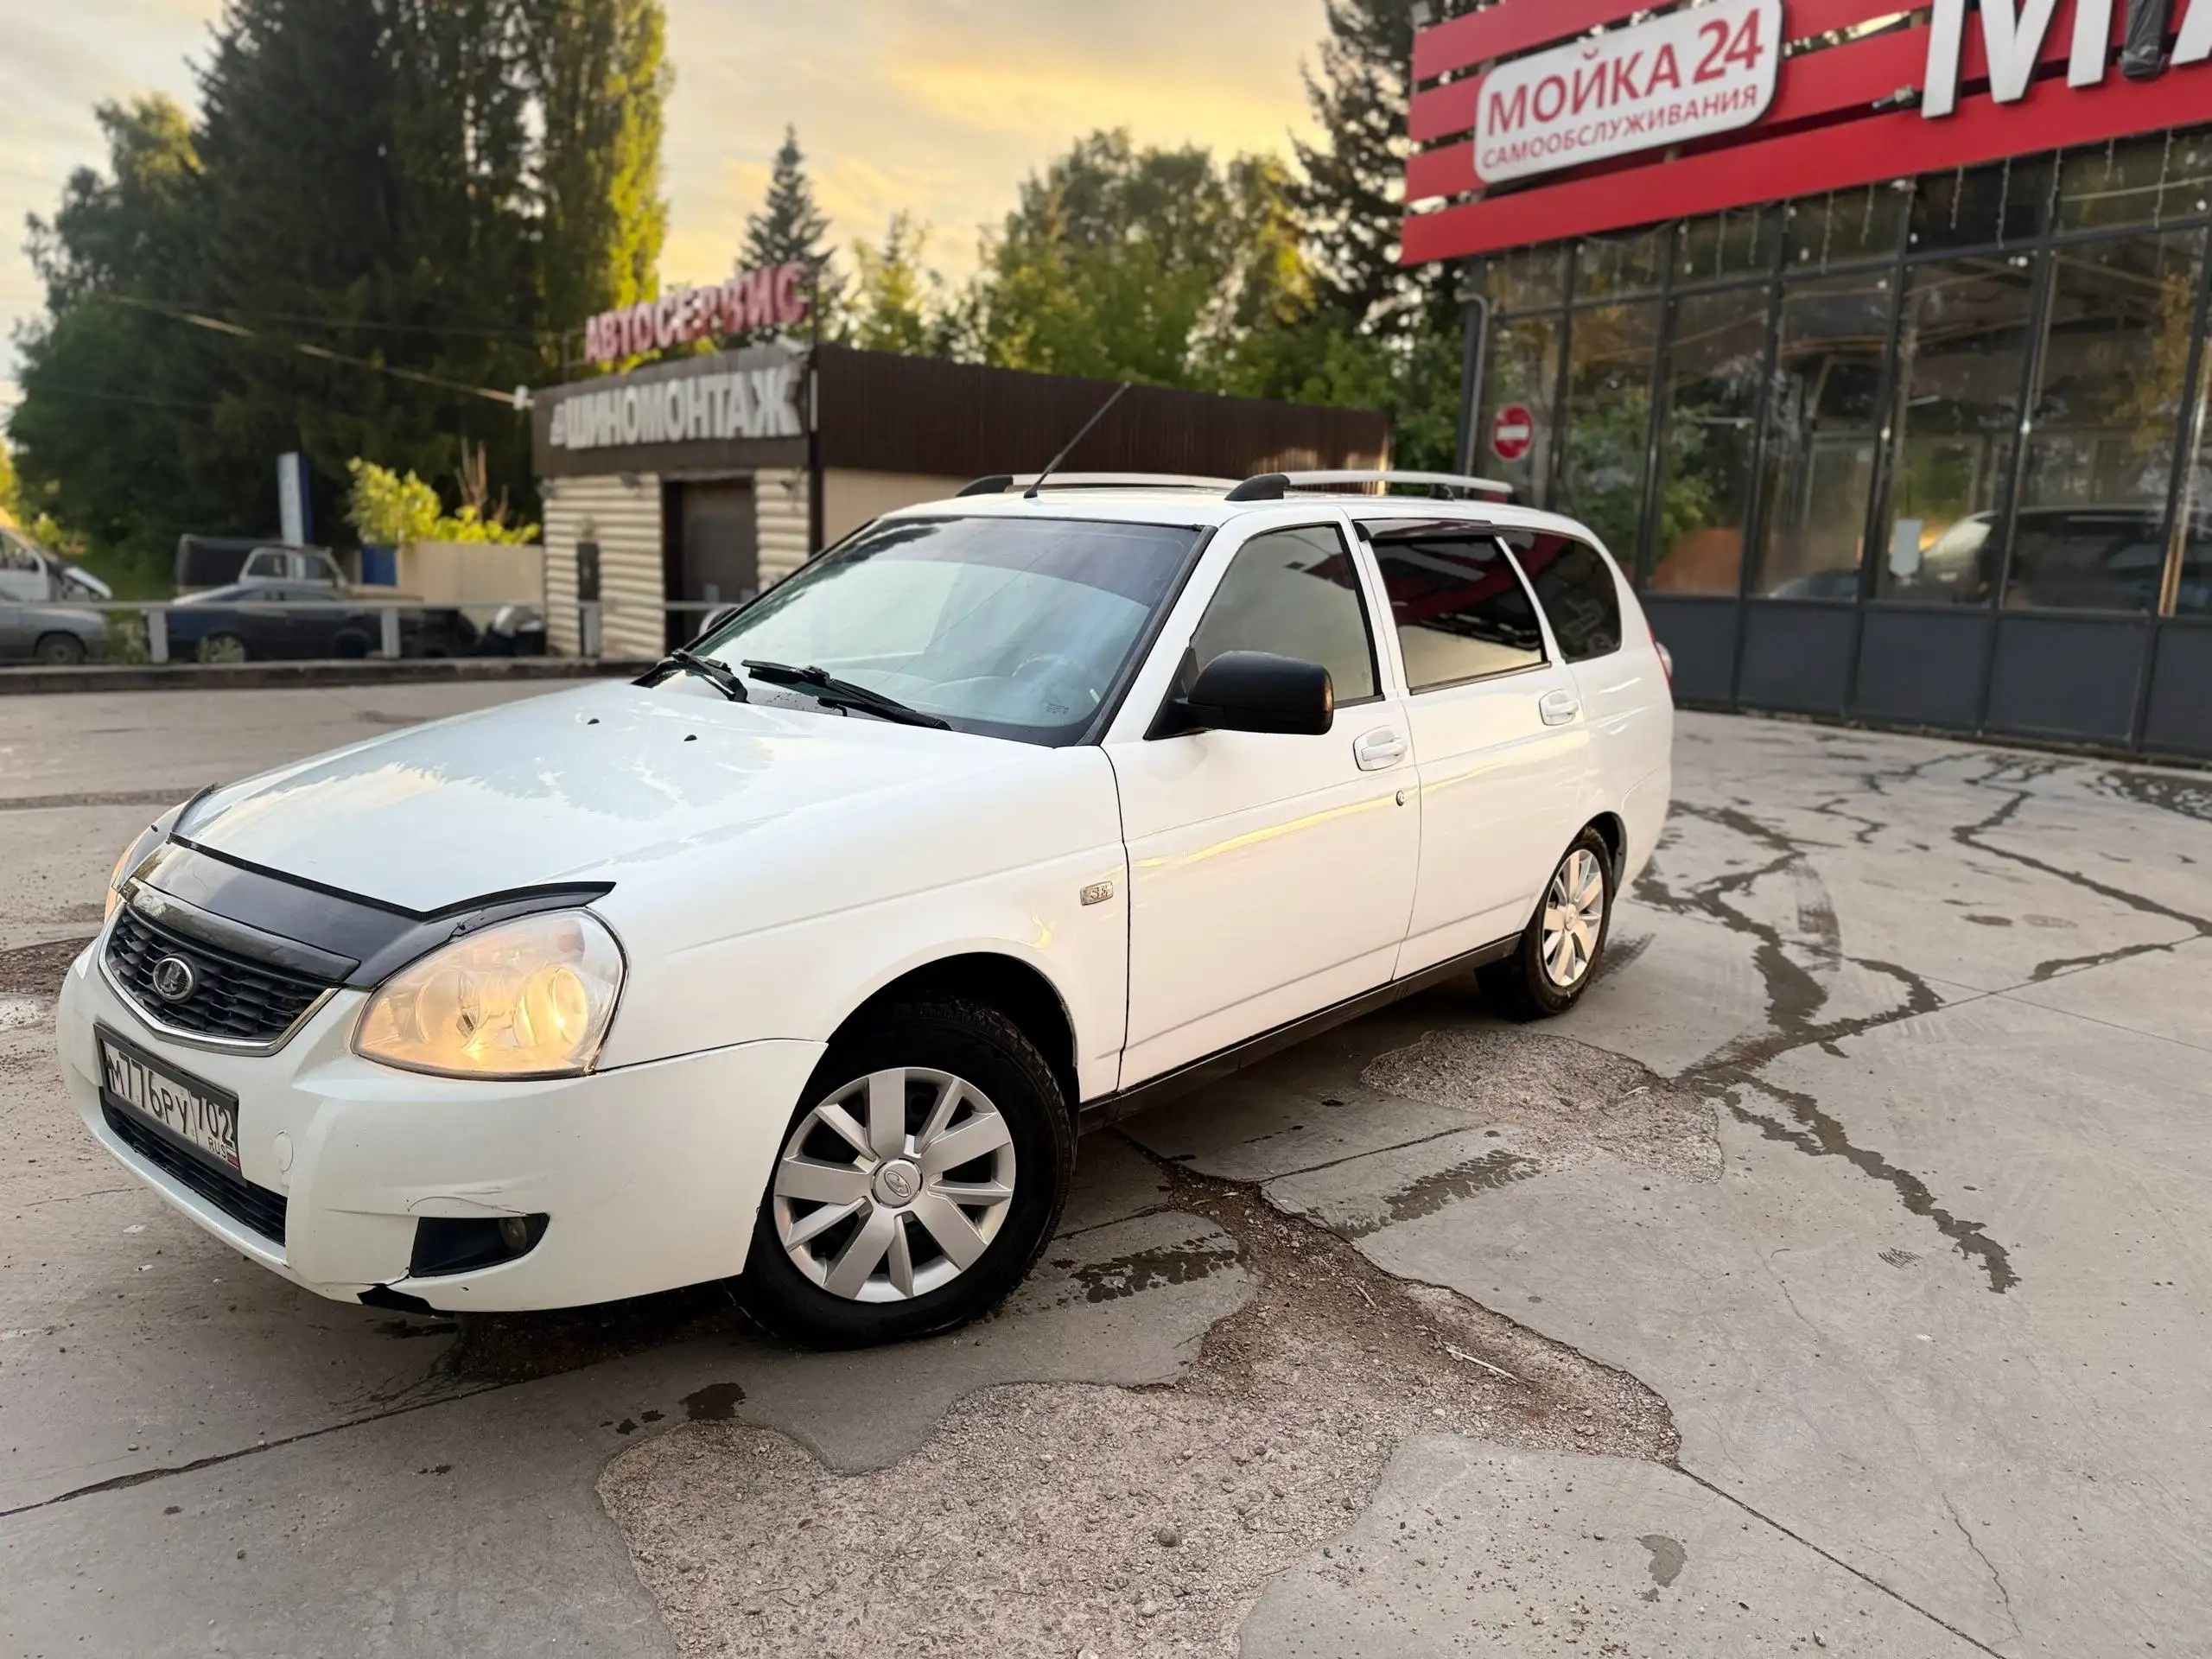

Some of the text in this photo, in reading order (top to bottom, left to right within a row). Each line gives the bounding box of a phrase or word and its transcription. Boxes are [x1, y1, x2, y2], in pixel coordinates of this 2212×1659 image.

[1487, 9, 1764, 137] МОЙКА 24
[1482, 84, 1758, 169] САМООБСЛУЖИВАНИЯ
[585, 261, 810, 365] АВТОСЕРВИС
[565, 365, 802, 450] ШИНОМОНТАЖ
[208, 1136, 226, 1159] RUS
